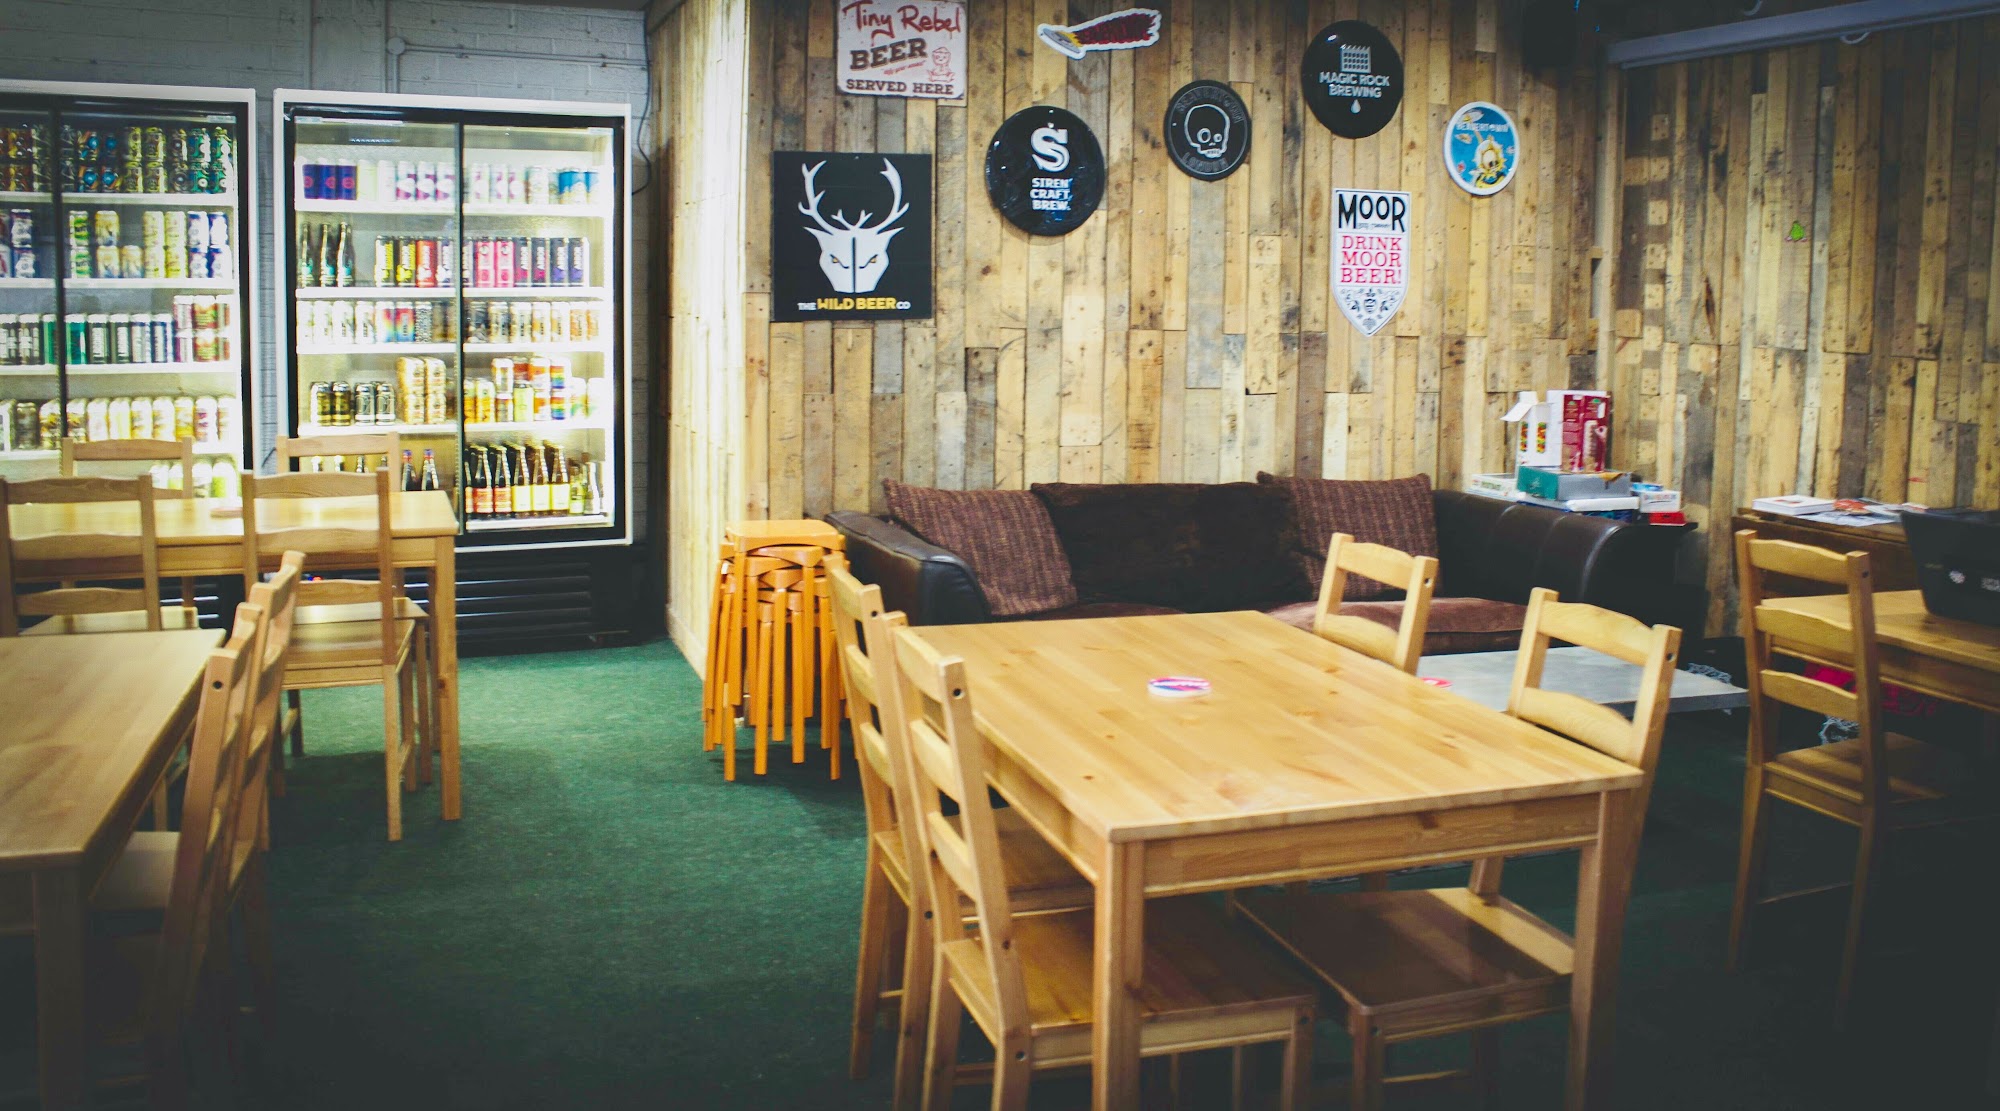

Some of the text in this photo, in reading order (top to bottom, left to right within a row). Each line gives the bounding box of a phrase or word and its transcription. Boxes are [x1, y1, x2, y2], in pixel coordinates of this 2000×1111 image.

[842, 0, 961, 41] Tiny Rebel
[850, 38, 927, 70] BEER
[846, 79, 953, 95] SERVED HERE
[1319, 71, 1390, 87] MAGIC ROCK
[1328, 84, 1382, 98] BREWING
[1031, 177, 1069, 188] SIREN
[1029, 188, 1070, 199] CRAFT
[1338, 193, 1406, 233] MOOR
[1341, 235, 1402, 251] DRINK
[1340, 250, 1401, 267] MOOR
[1340, 267, 1402, 284] BEER!
[797, 297, 911, 311] THE WILD BEER CO
